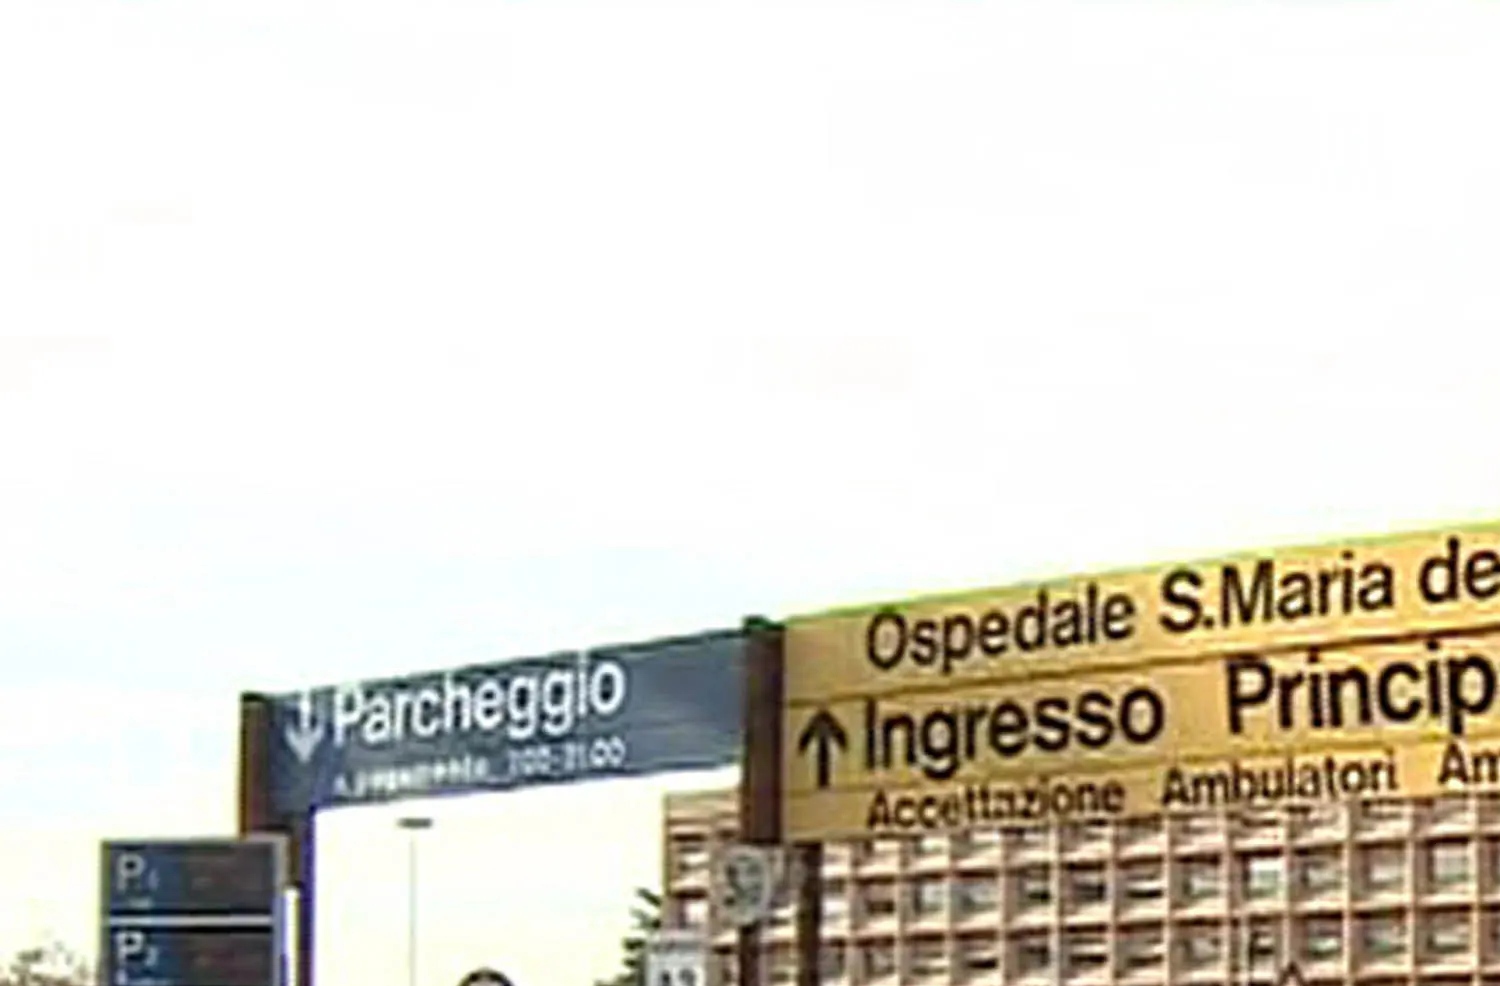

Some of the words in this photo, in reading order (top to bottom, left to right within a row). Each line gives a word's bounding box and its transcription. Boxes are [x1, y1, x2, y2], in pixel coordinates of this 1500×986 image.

[867, 585, 1136, 670] Ospedale
[1159, 551, 1395, 635] S.Maria
[333, 655, 626, 745] Parcheggio
[865, 685, 1165, 780] Ingresso
[866, 776, 1126, 829] Accettazione
[1161, 750, 1398, 806] Ambulatori
